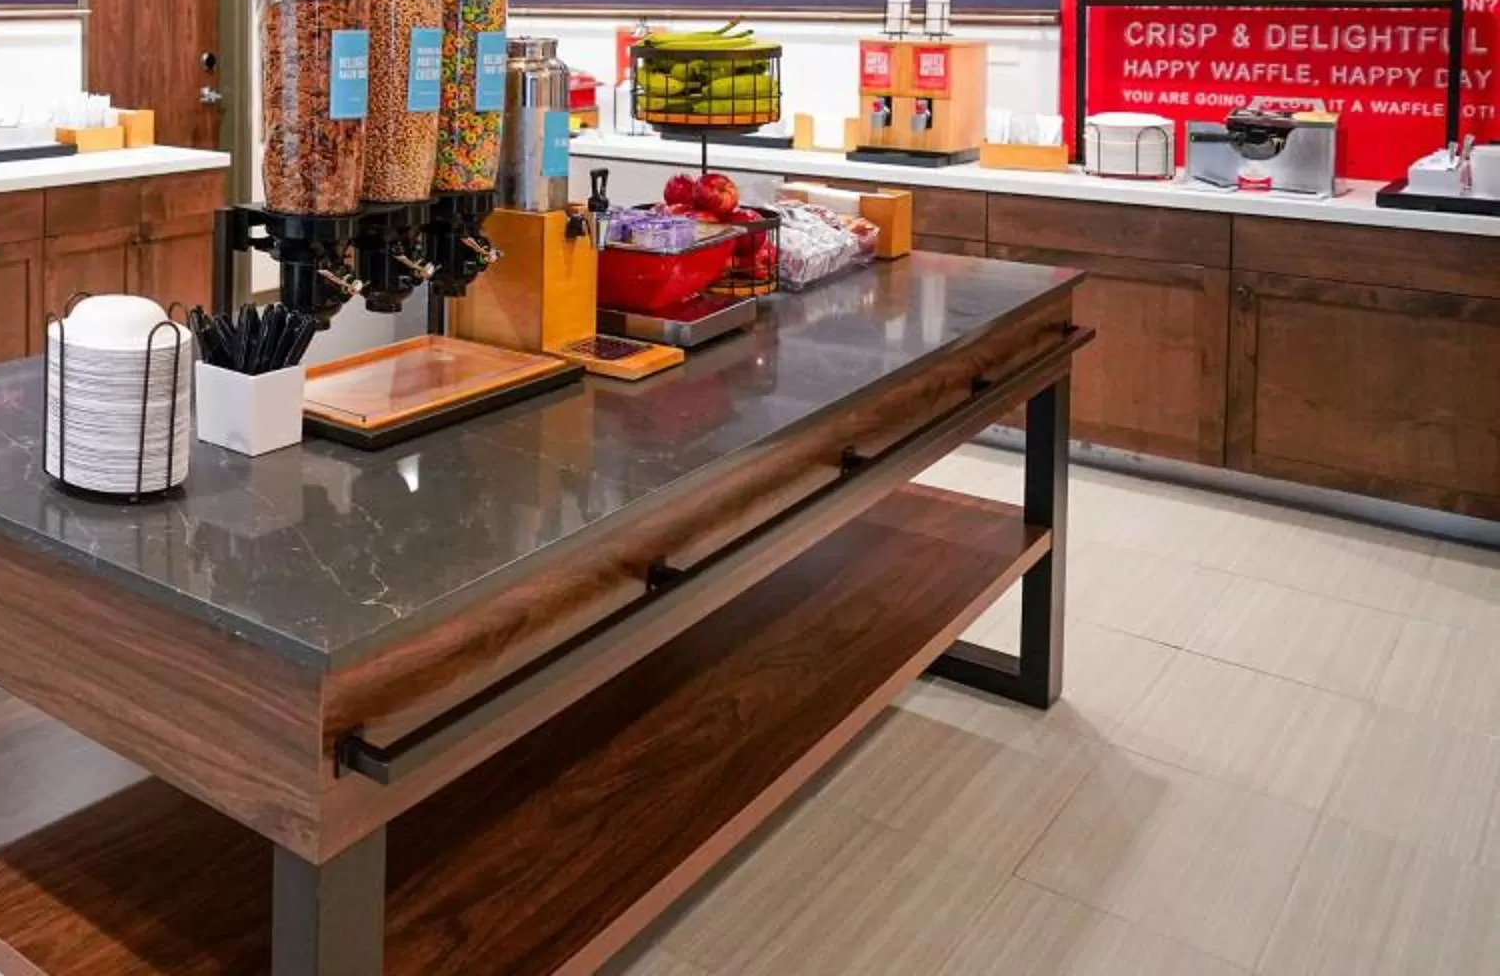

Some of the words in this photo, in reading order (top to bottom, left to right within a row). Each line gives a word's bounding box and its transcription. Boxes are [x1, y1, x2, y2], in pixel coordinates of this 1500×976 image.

[1124, 22, 1218, 48] CRISP
[1231, 23, 1251, 49] &
[1123, 59, 1200, 79] HAPPY
[1210, 61, 1320, 86] WAFFLE,
[1331, 64, 1423, 88] HAPPY
[1123, 89, 1153, 103] YOU
[1158, 91, 1189, 105] ARE
[1195, 92, 1246, 107] GOING
[1328, 99, 1345, 111] IT
[1351, 99, 1364, 112] A
[1370, 99, 1444, 117] WAFFLE
[1461, 103, 1495, 120] OT!
